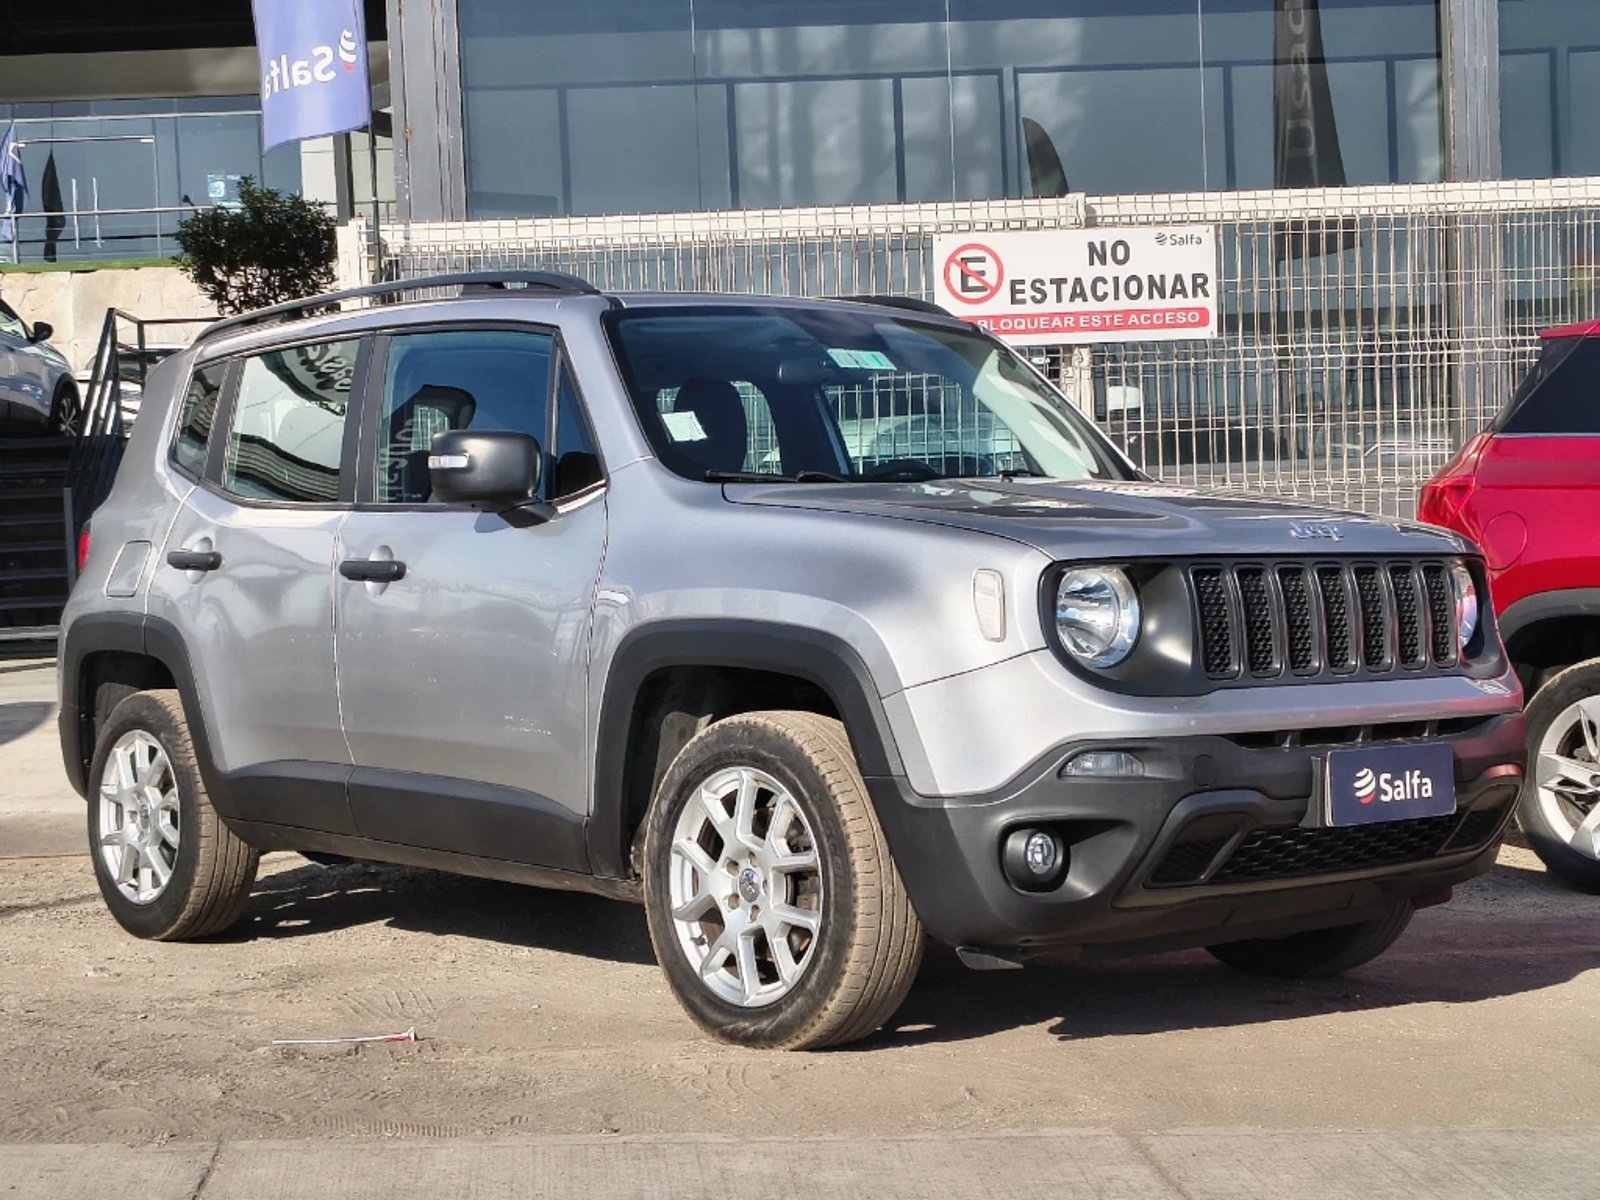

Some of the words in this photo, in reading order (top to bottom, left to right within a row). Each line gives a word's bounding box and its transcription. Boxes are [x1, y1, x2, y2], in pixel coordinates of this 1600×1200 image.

[1169, 233, 1203, 246] Salfa
[1087, 240, 1131, 267] NO
[1009, 272, 1210, 306] ESTACIONAR
[1080, 314, 1124, 328] ESTE
[1128, 311, 1200, 326] ACCESO
[1379, 769, 1433, 802] Salfa
